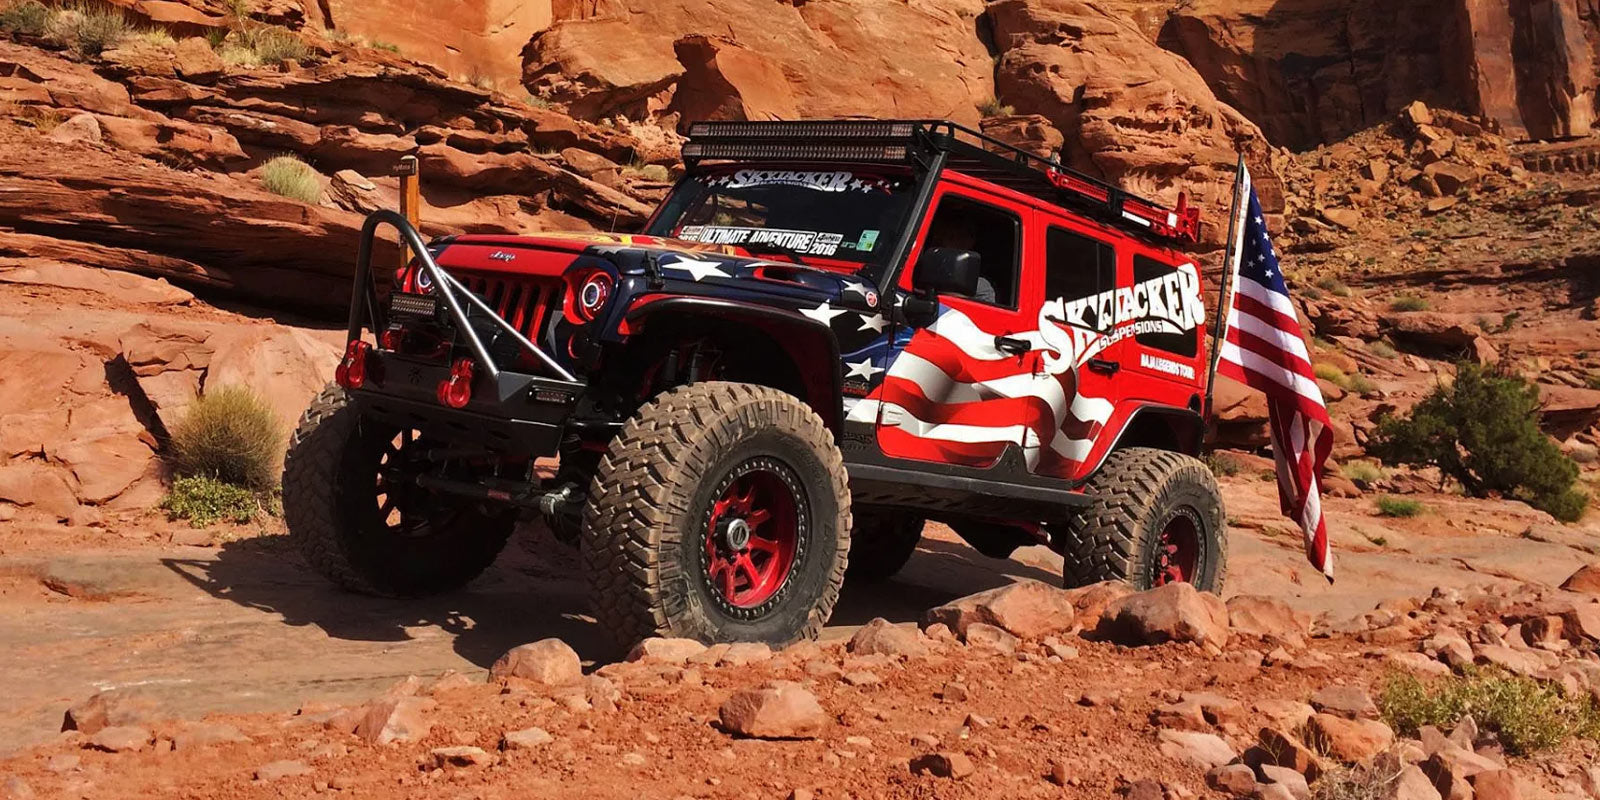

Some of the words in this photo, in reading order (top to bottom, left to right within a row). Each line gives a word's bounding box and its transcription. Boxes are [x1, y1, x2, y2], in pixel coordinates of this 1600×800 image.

[728, 169, 853, 192] SKYJACKER
[700, 228, 751, 244] ULTIMATE
[750, 229, 812, 250] ADVENTURE
[809, 242, 838, 256] 2016
[1038, 263, 1206, 375] SKYJACKER
[1099, 320, 1164, 350] SUSPENSIONS
